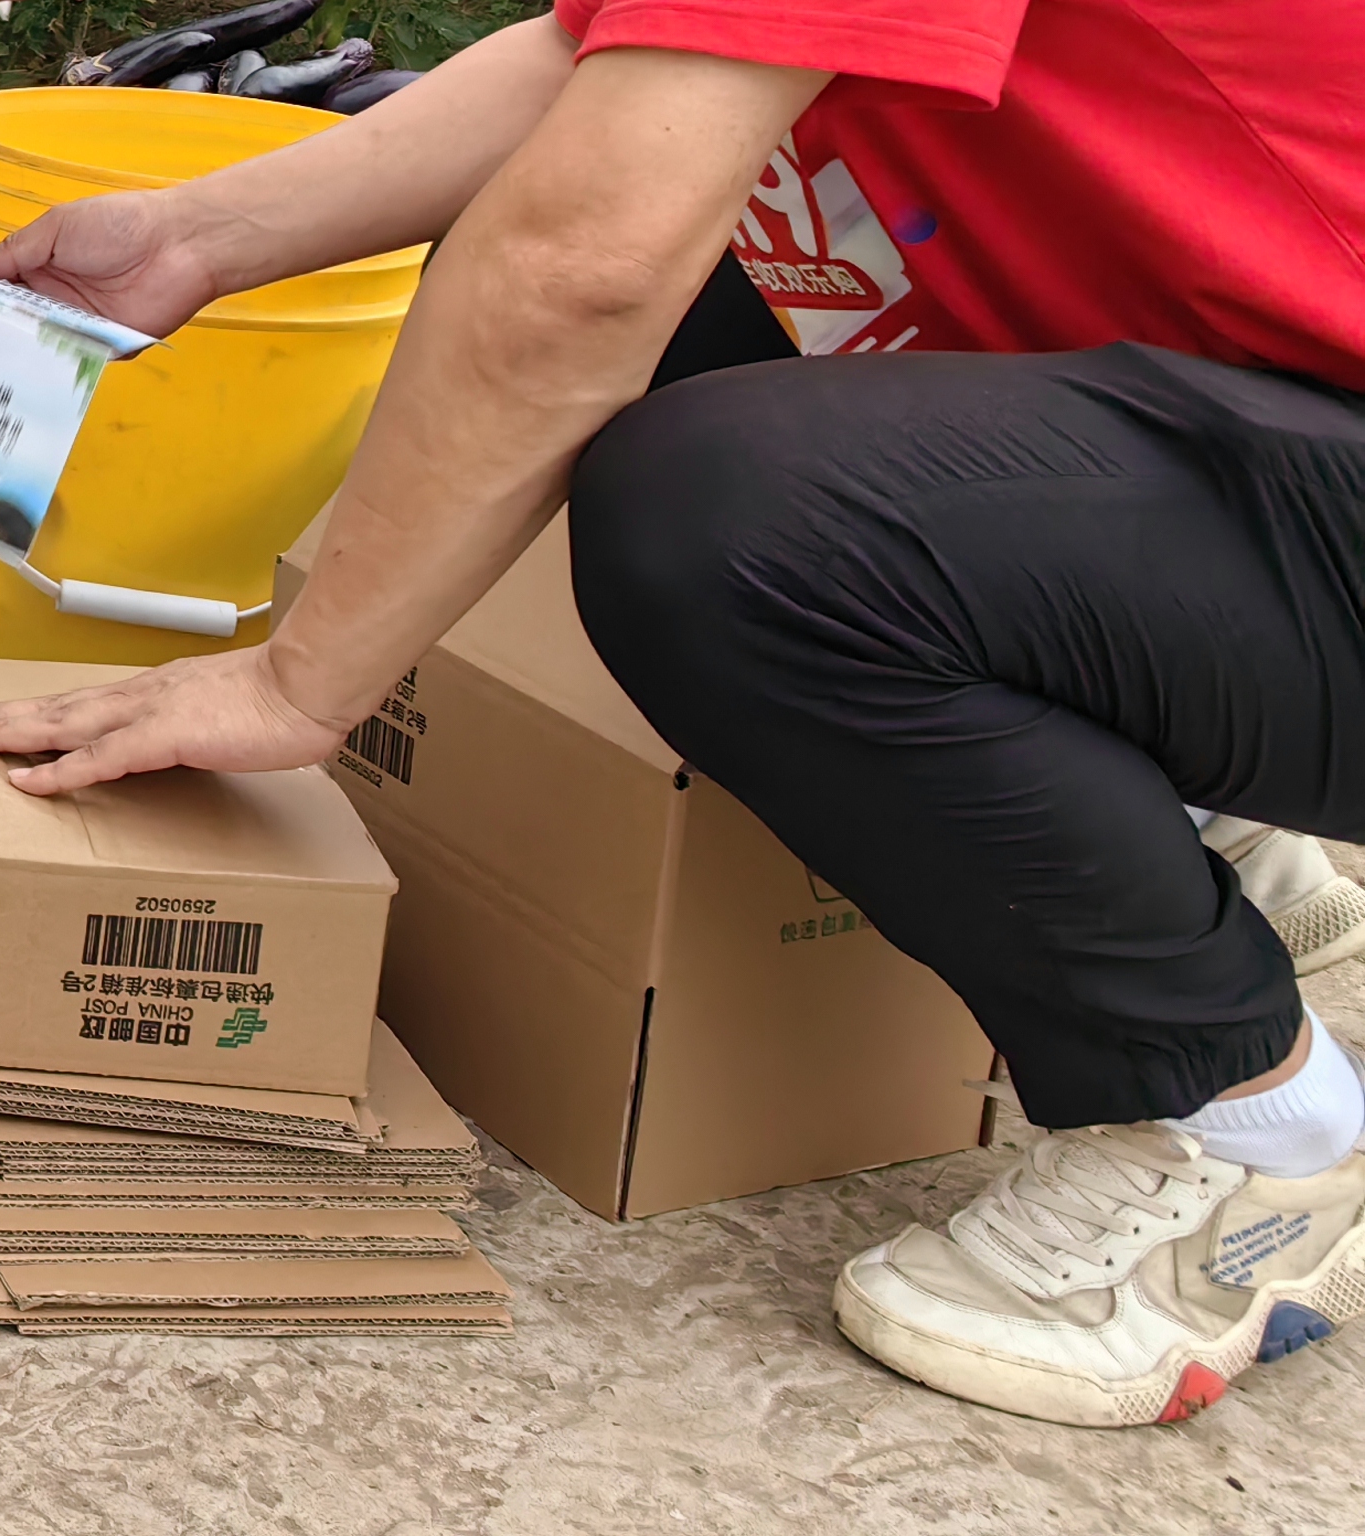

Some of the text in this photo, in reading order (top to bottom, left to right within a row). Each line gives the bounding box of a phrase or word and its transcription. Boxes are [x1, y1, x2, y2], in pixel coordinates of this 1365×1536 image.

[135, 896, 217, 915] 2590502
[60, 970, 275, 1006] 快递包裹标准箱2号
[80, 997, 195, 1022] CHINA POST
[78, 1014, 192, 1047] 中国邮政
